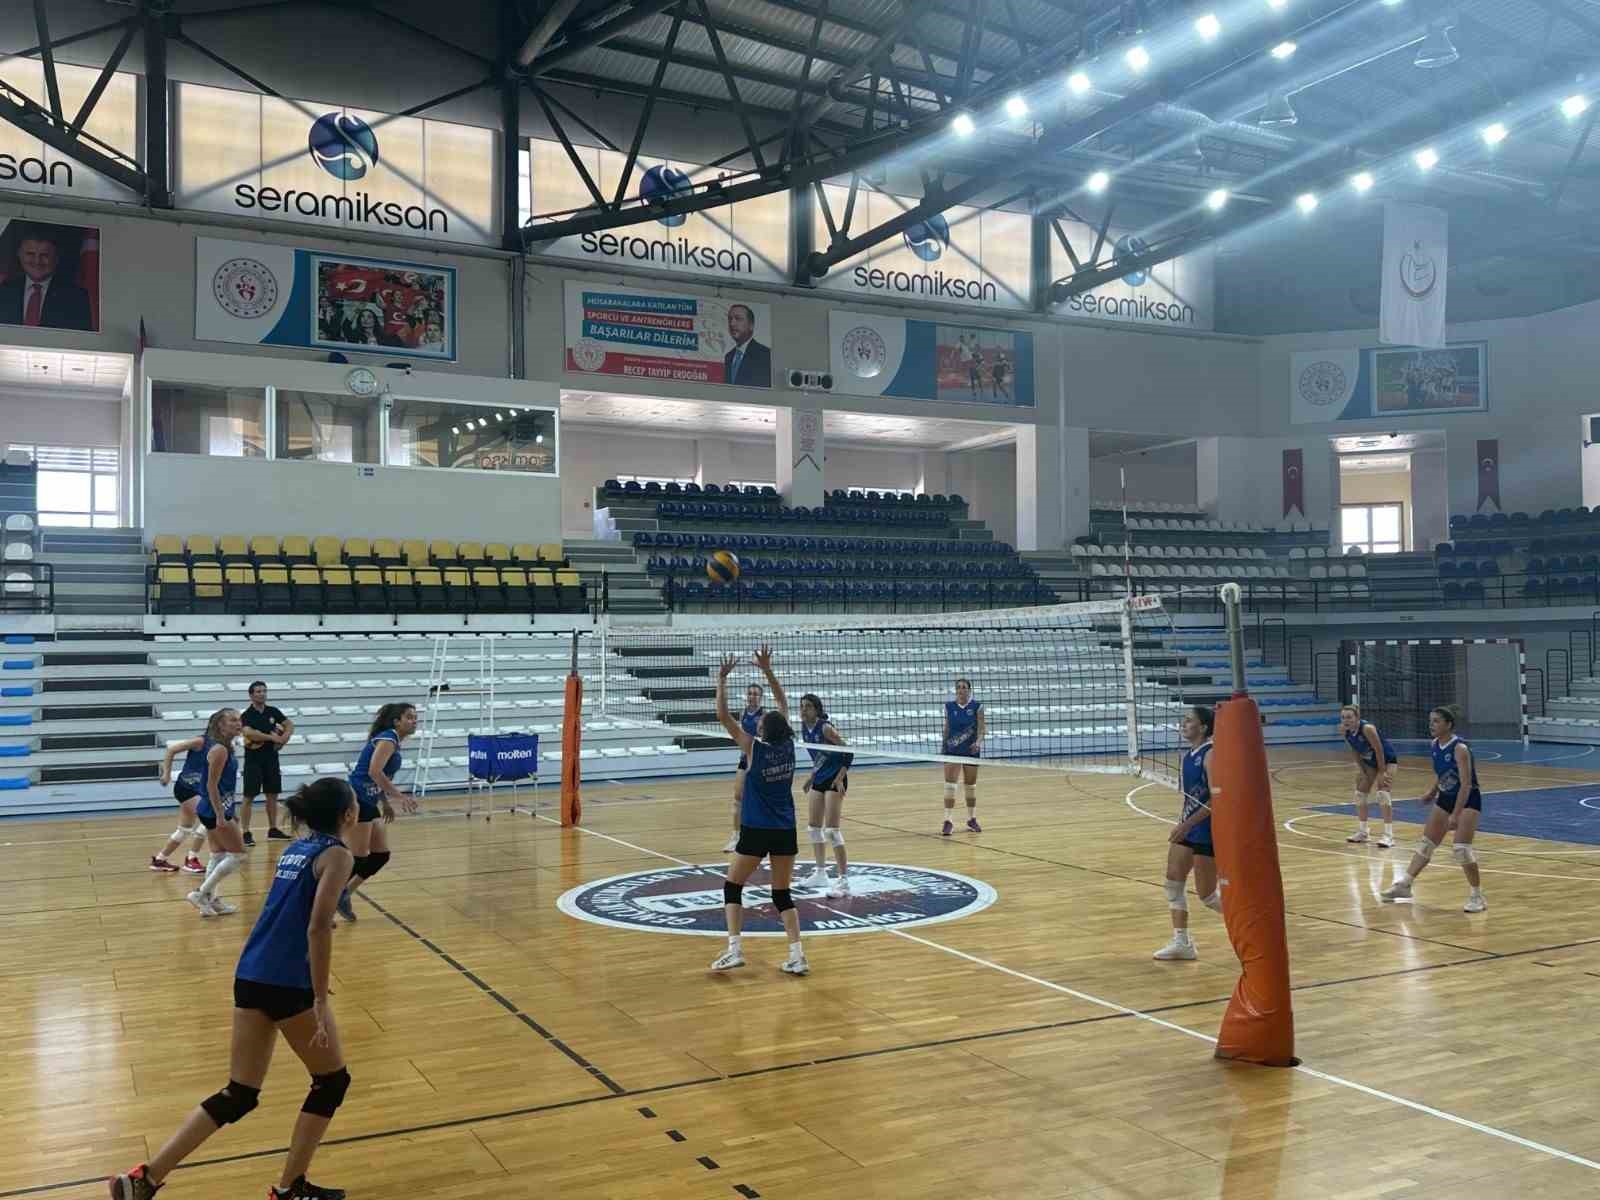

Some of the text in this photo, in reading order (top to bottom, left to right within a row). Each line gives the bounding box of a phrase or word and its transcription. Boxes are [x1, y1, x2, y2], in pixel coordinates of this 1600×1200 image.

[234, 182, 448, 234] seramiksan
[580, 230, 752, 273] seramiksan
[853, 265, 997, 303] seramiksan
[1069, 292, 1194, 324] seramiksan
[590, 324, 696, 346] BAŞARILAR DİLERİM
[623, 365, 646, 376] RECEP
[648, 366, 671, 378] TAYYİP
[497, 749, 532, 760] molten
